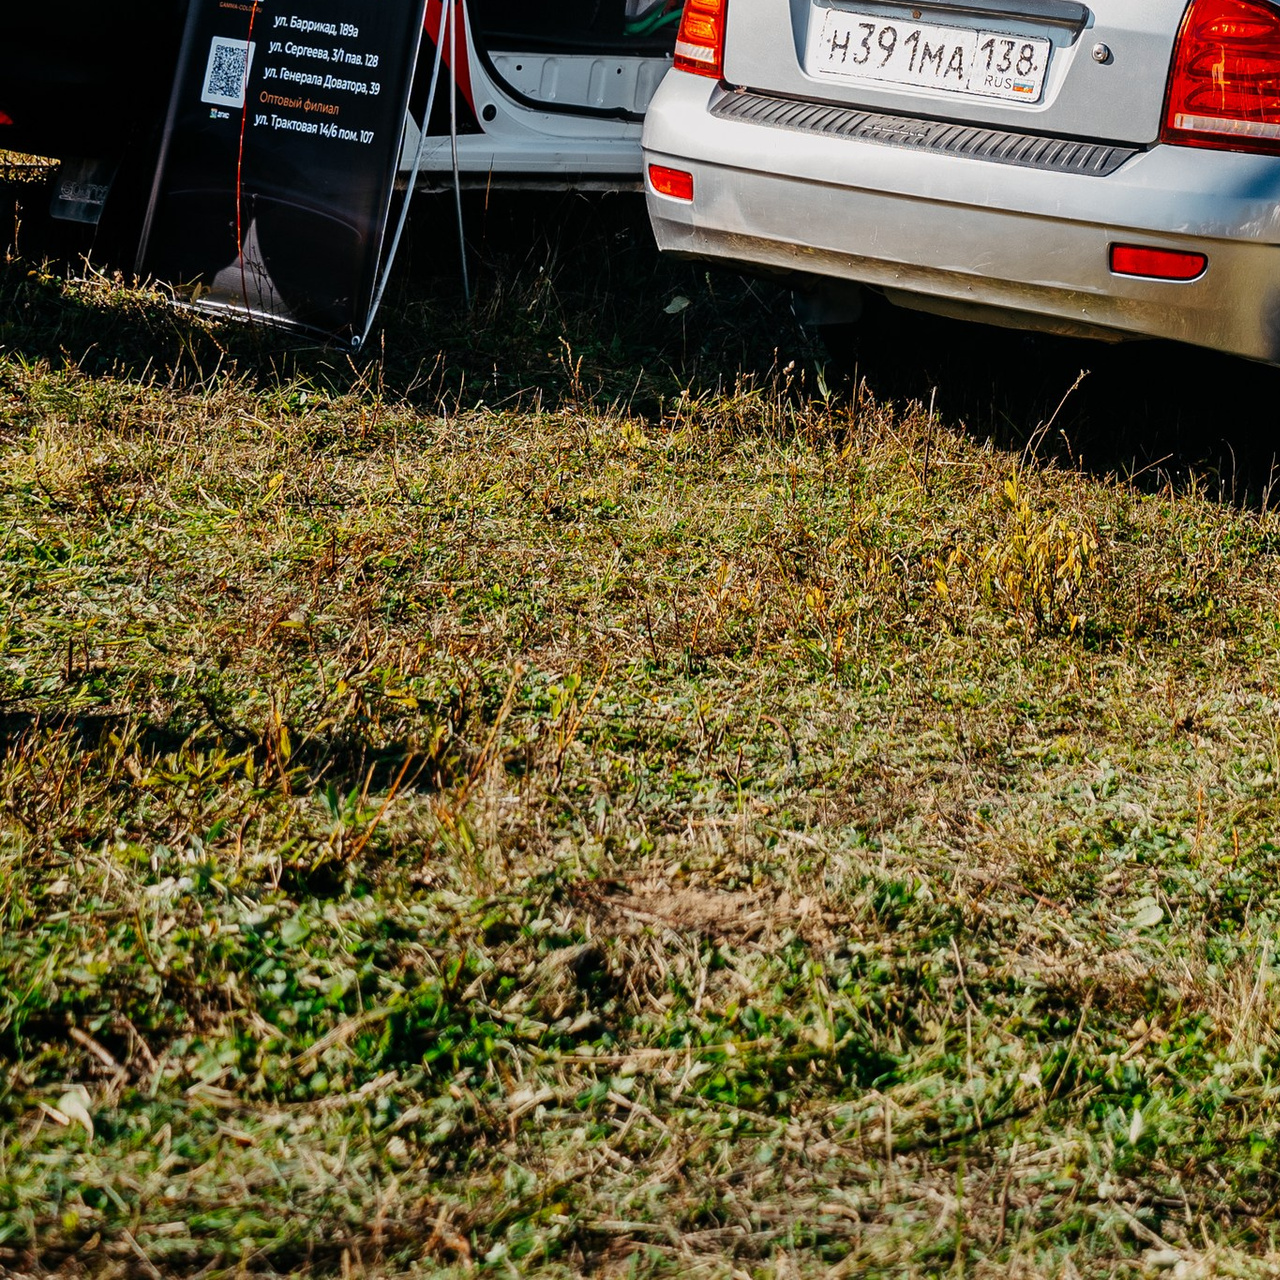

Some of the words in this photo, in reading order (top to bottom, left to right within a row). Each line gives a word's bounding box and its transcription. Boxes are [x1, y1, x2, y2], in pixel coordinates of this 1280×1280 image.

[273, 15, 288, 29] ул.
[290, 16, 338, 36] Баррикад,
[339, 22, 359, 38] 189а
[268, 40, 283, 54] ул.
[284, 42, 330, 62] Сергеева,
[331, 48, 344, 62] 3/1
[345, 51, 363, 66] пав.
[365, 53, 379, 68] 128
[829, 22, 964, 81] Н391МА
[981, 38, 1034, 77] 138
[263, 66, 278, 80] ул.
[279, 67, 323, 87] Генерала
[323, 74, 368, 95] Доватора,
[369, 81, 381, 96] 39
[984, 74, 1012, 90] RUS
[259, 90, 303, 109] Оптовый
[303, 98, 340, 115] филиал
[254, 113, 269, 127] ул.
[271, 114, 318, 135] Трактовая
[319, 122, 338, 138] 14/6
[338, 126, 358, 142] пом.
[359, 130, 374, 145] 107
